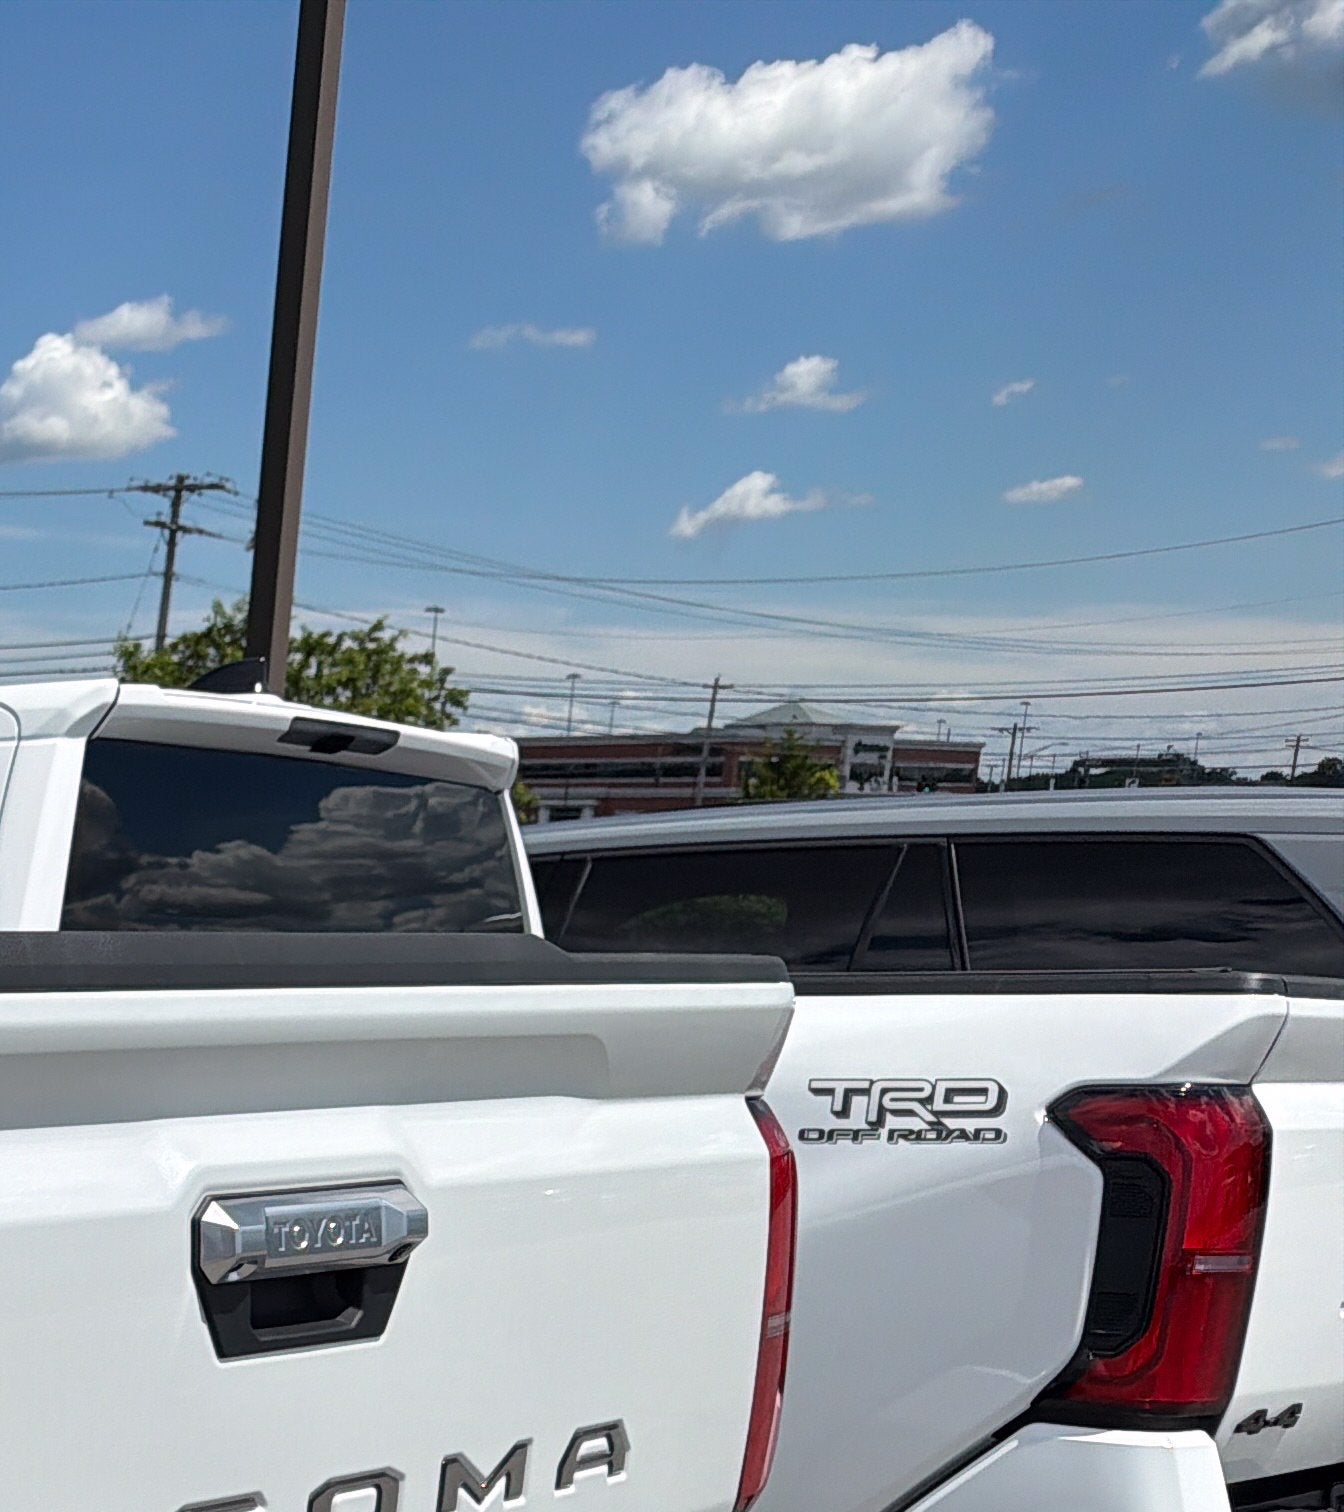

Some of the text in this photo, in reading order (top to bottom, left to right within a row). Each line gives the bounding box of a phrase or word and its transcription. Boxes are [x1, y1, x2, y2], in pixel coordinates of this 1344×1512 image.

[808, 1078, 1008, 1130] TRD
[798, 1128, 1008, 1144] OFF ROAD
[272, 1214, 378, 1252] TOYOTA
